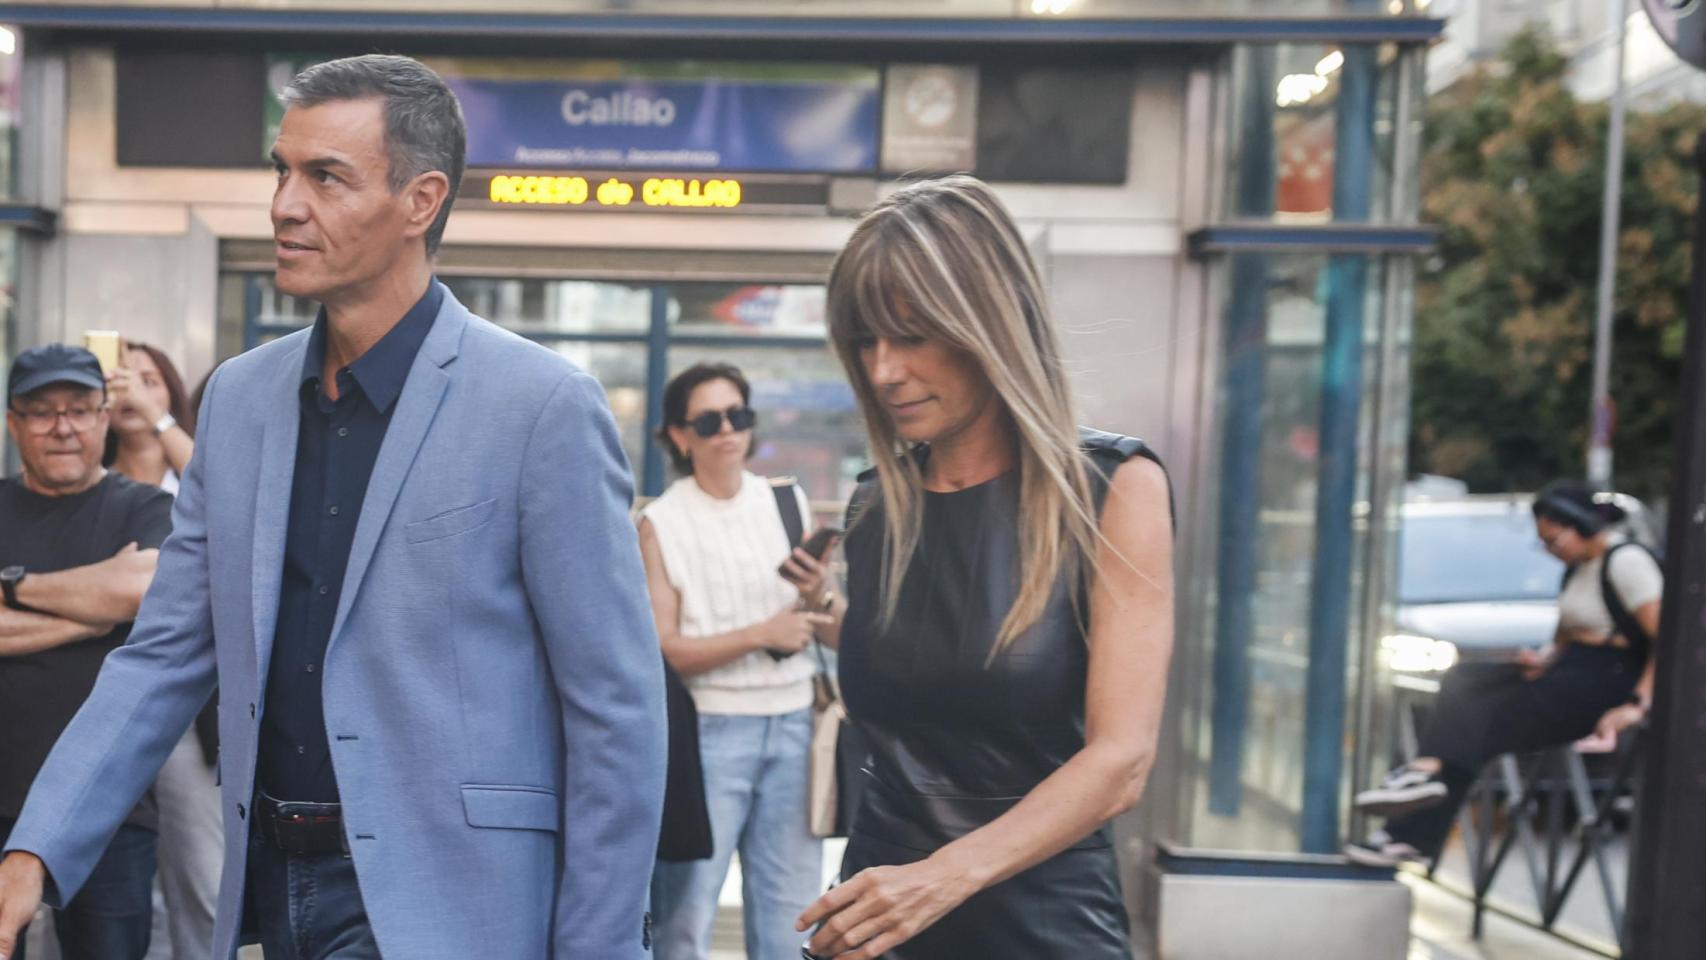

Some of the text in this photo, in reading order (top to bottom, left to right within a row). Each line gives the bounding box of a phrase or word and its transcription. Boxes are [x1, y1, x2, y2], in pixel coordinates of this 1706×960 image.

[561, 90, 676, 126] Callao
[490, 175, 588, 204] ACCESO
[642, 178, 741, 207] CALLAO
